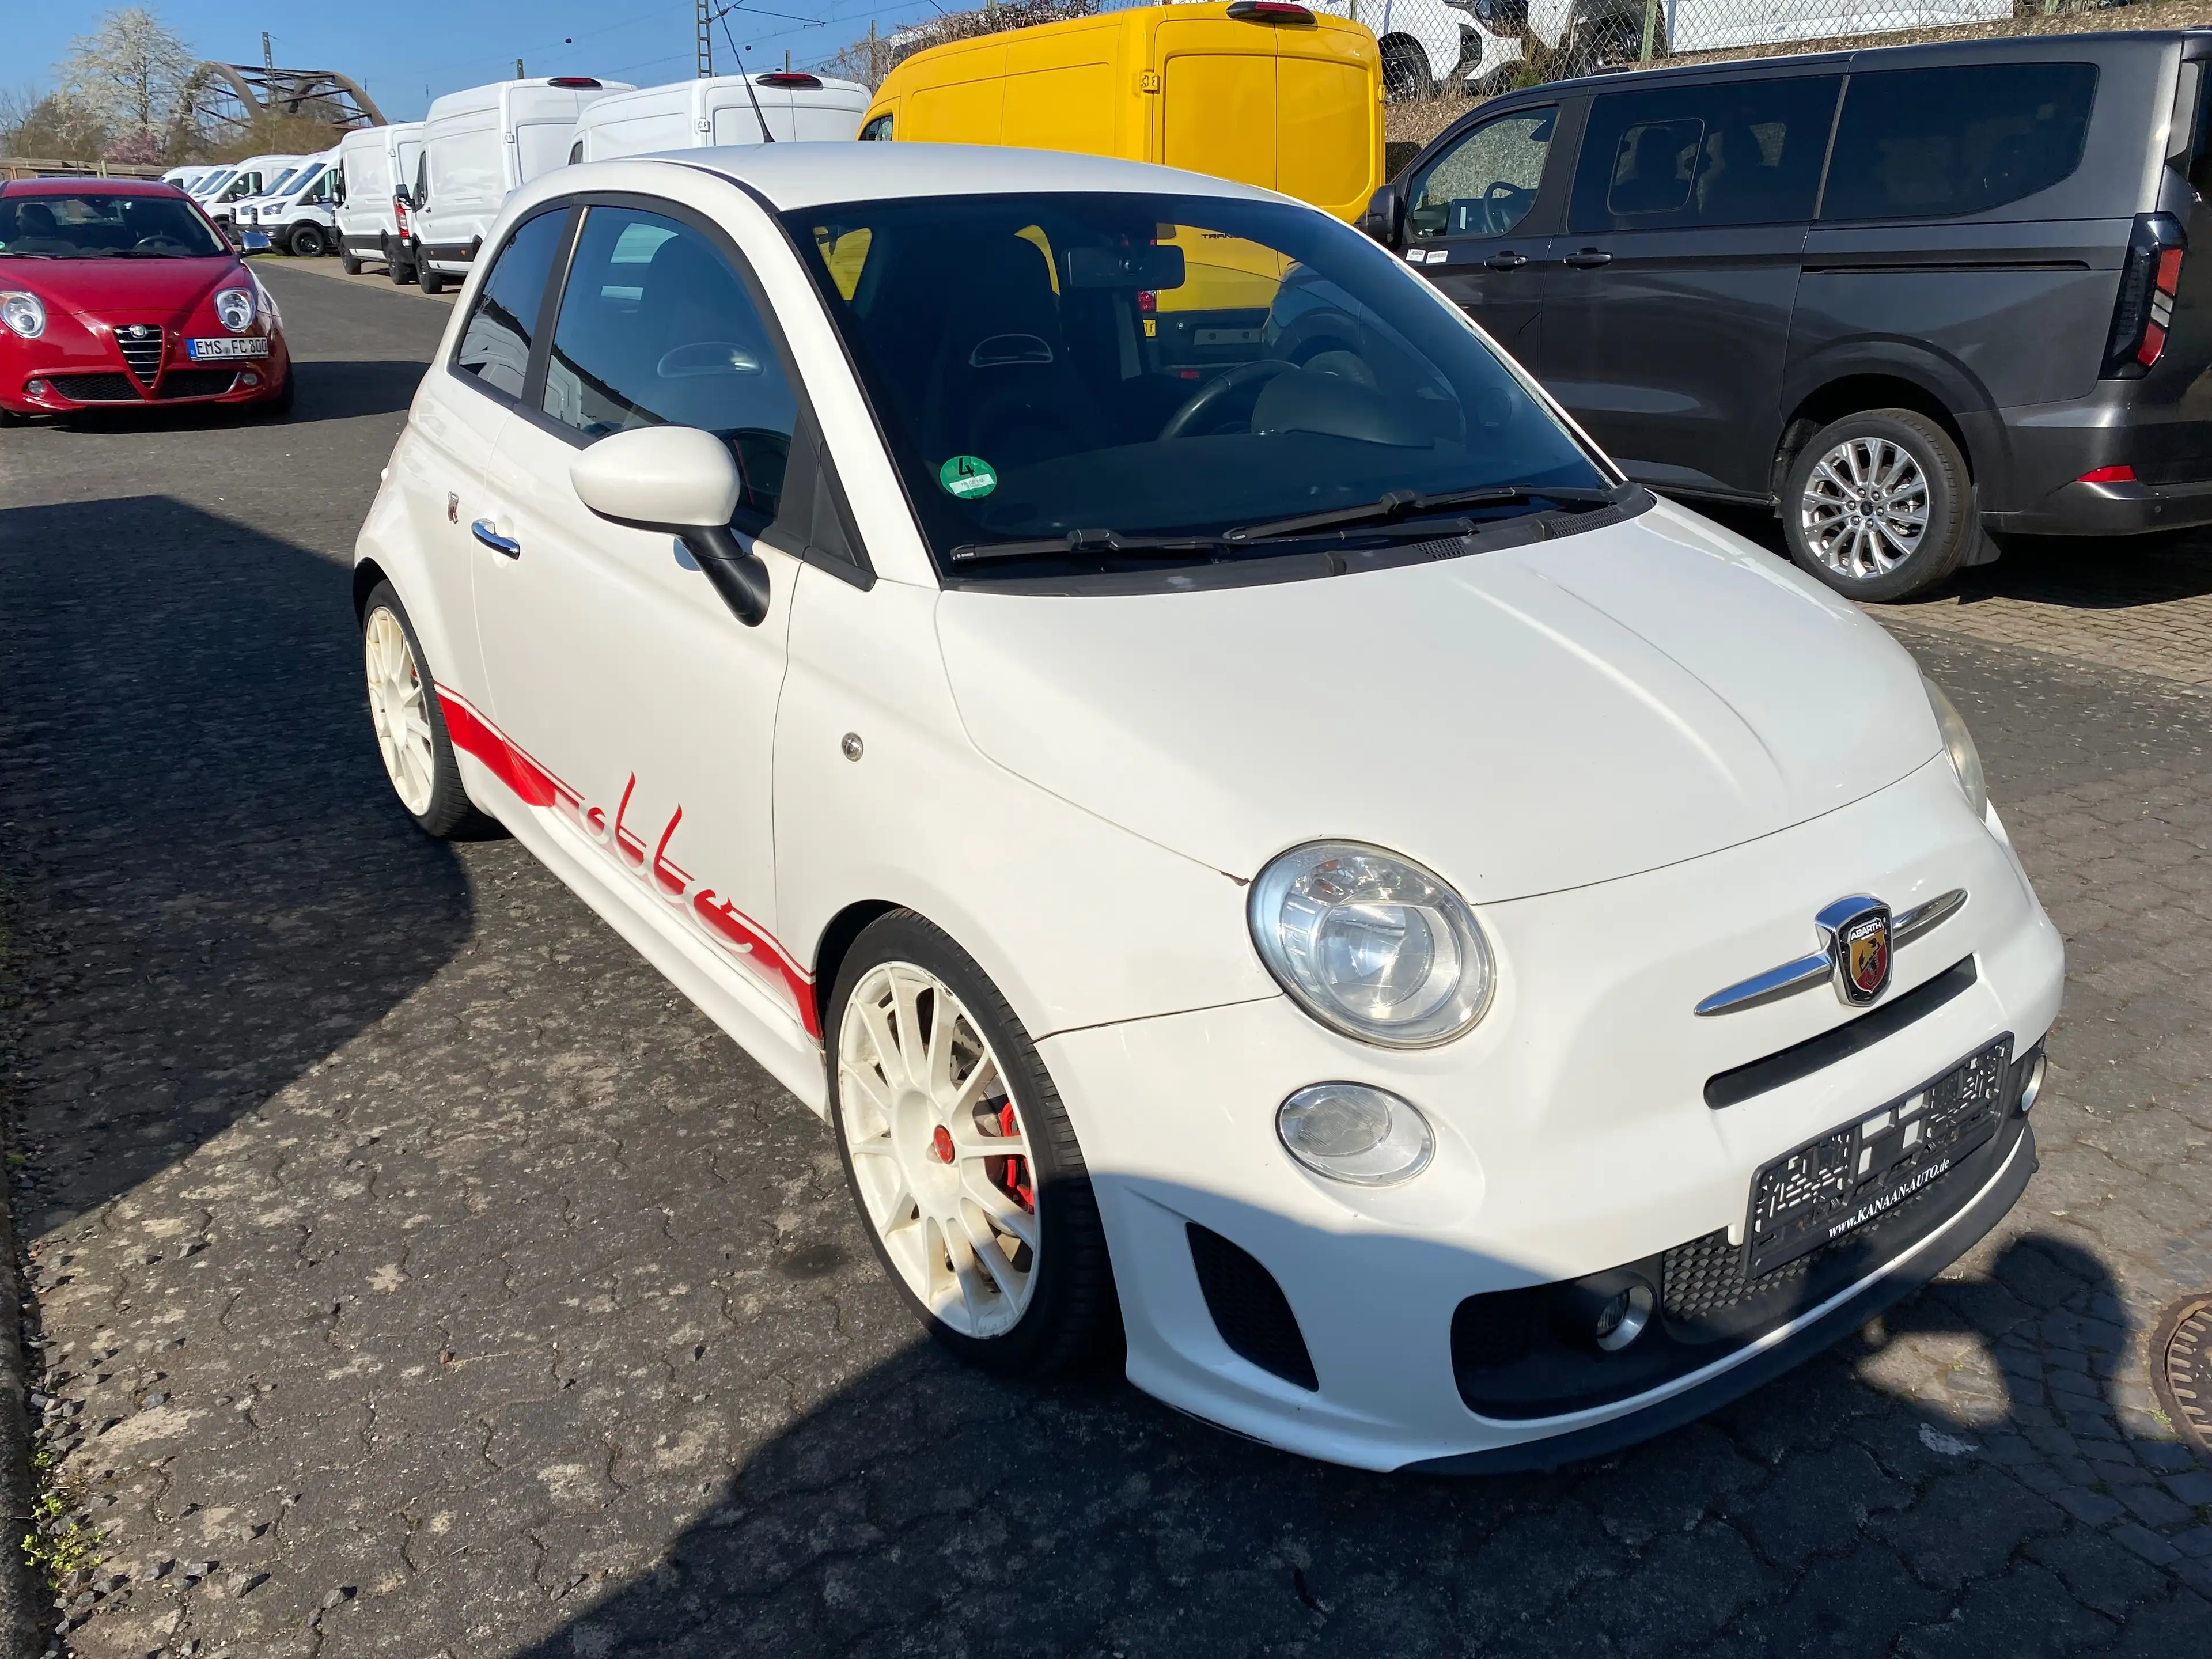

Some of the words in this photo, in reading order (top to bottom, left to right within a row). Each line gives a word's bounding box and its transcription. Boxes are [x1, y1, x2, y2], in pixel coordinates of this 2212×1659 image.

[195, 340, 222, 355] EMS
[231, 340, 247, 353] FC
[249, 339, 267, 353] 800
[958, 457, 975, 477] 4
[1850, 922, 1882, 941] ABARTH
[1828, 1158, 1950, 1238] www.KANAAN-AUTO.de
